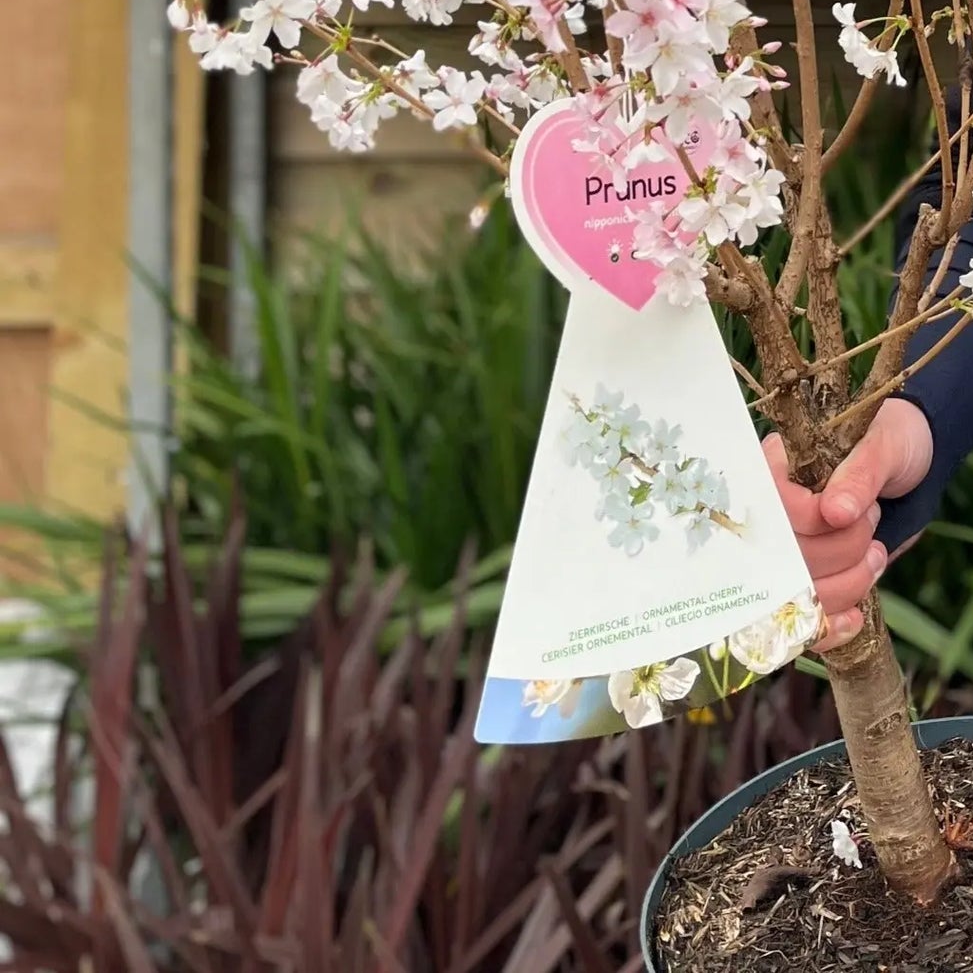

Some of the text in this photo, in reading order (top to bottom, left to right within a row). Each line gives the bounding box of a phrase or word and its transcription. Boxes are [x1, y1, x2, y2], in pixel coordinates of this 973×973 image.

[585, 175, 677, 206] Prunus
[568, 585, 744, 642] ZIERKIRSCHE ORNAMENTAL CHERRY
[541, 642, 584, 663] CERISIER
[585, 623, 653, 651] ORNEMENTAL
